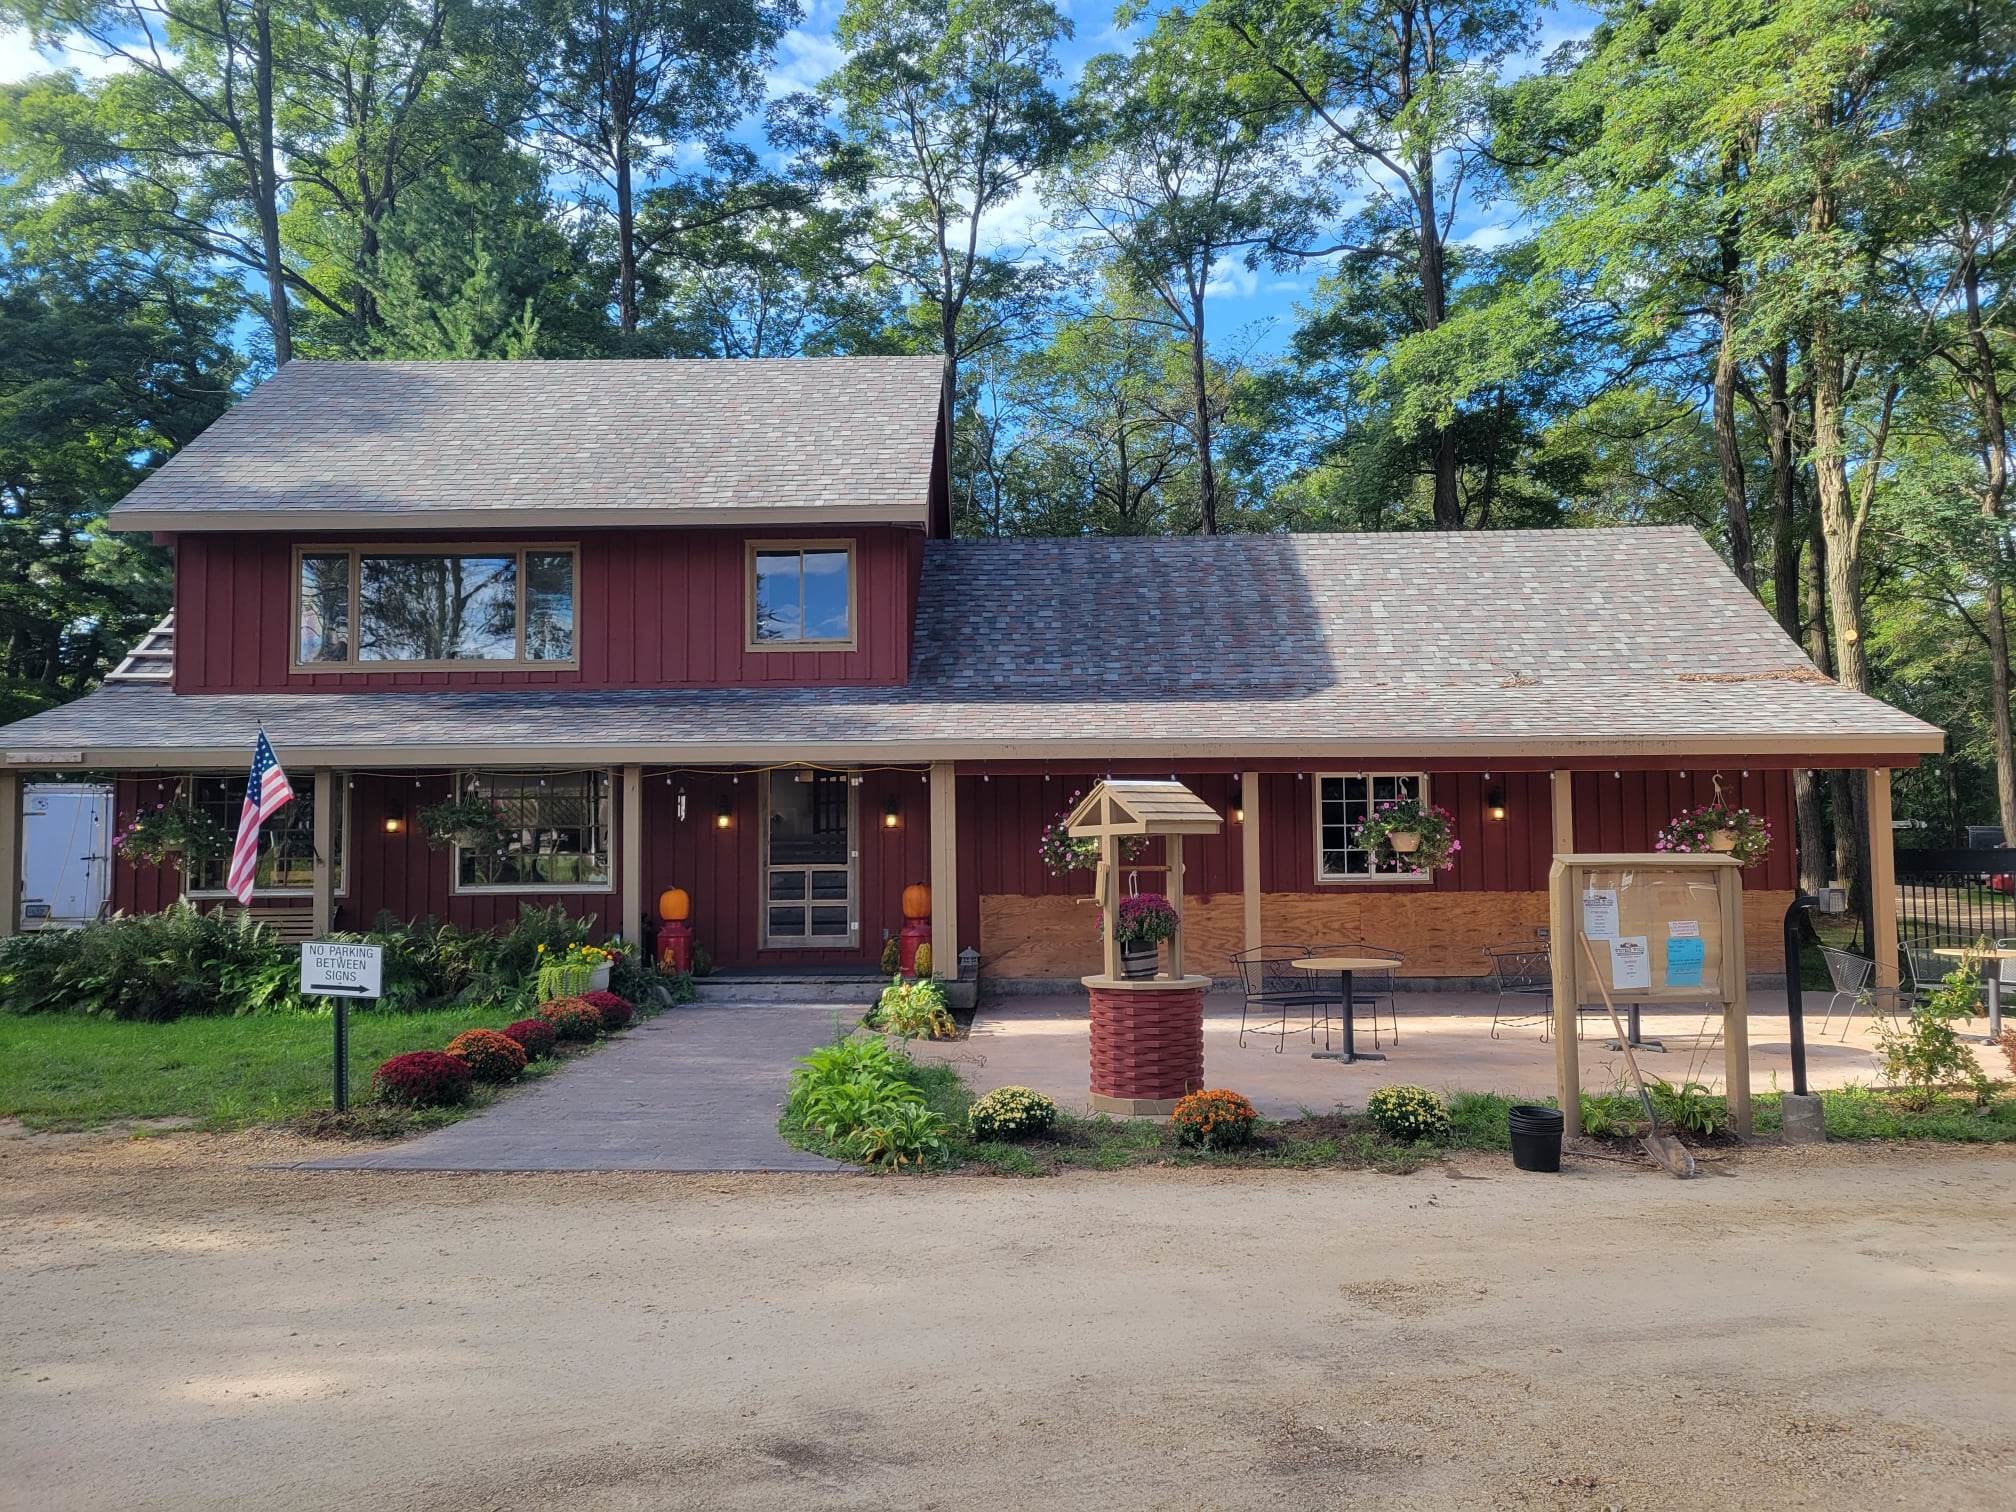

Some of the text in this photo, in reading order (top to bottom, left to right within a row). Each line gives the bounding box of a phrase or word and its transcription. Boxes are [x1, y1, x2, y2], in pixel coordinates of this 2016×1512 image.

[309, 945, 374, 958] NO PARKING
[316, 958, 366, 970] BETWEEN
[325, 970, 357, 981] SIGNS
